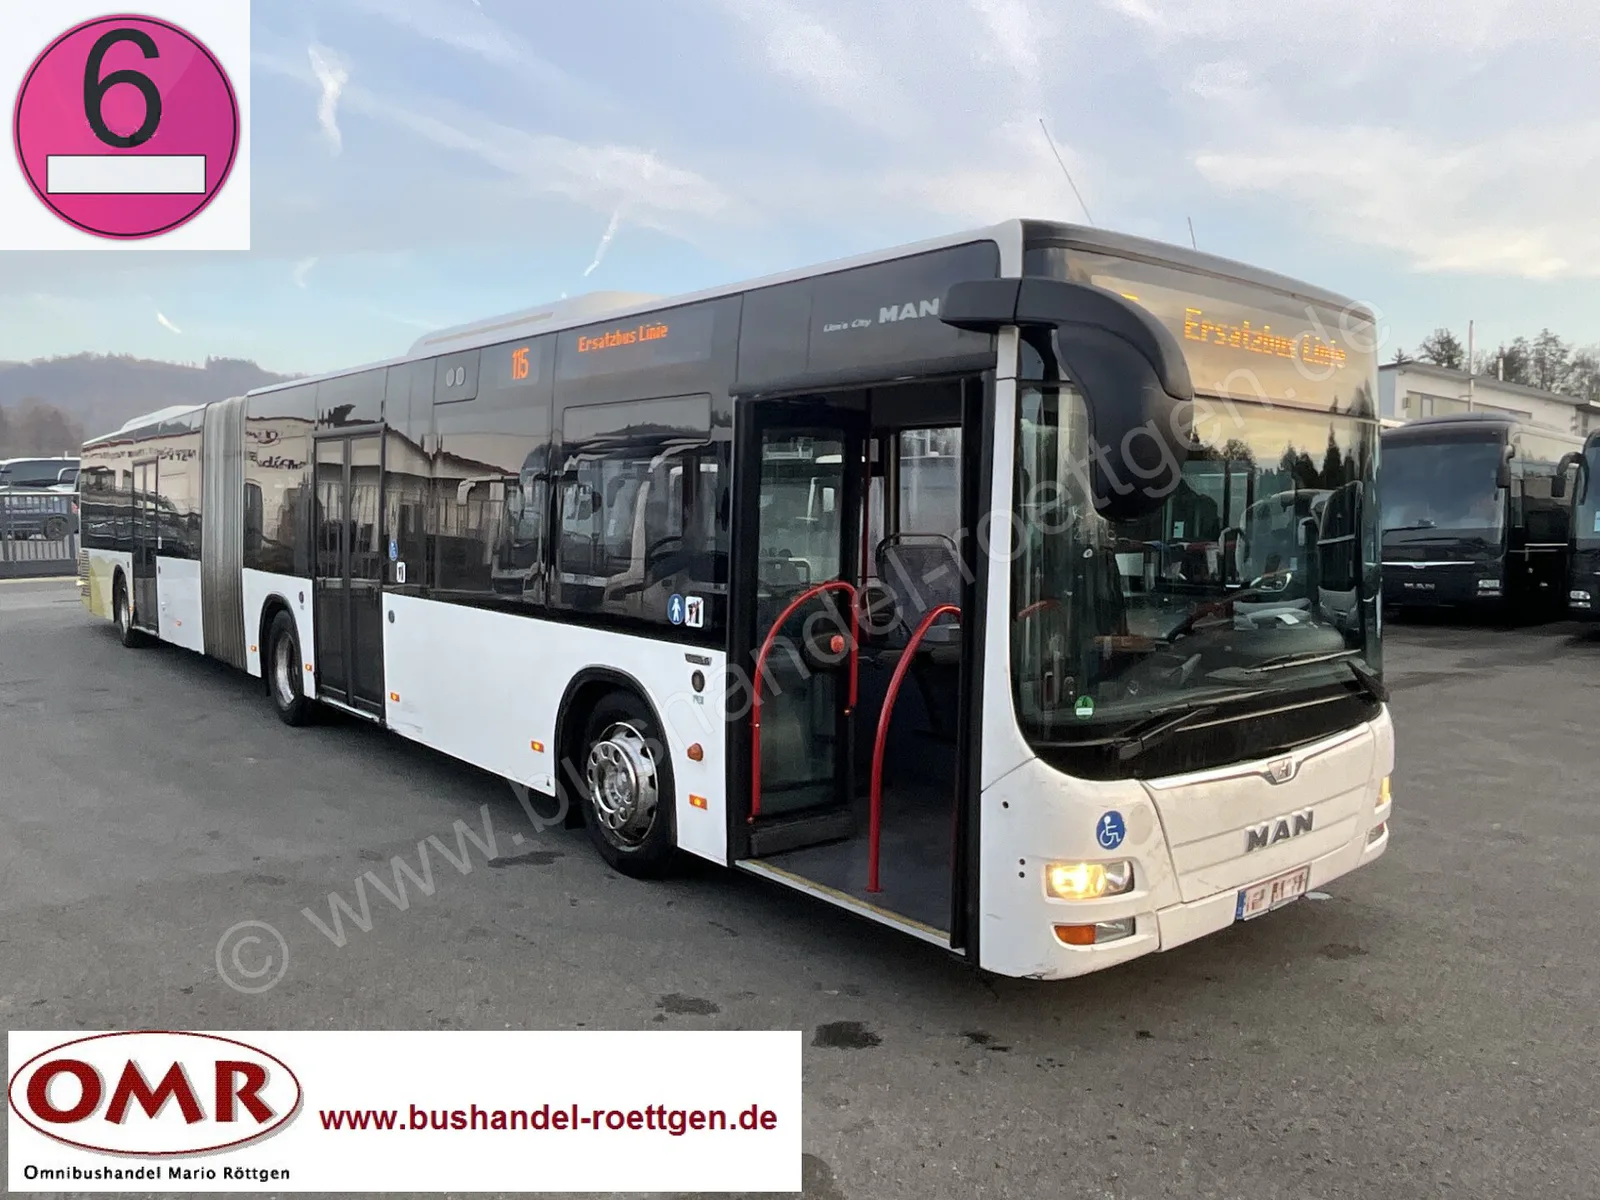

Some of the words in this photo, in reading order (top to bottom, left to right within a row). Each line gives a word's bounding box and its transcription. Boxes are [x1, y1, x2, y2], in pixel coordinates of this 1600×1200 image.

[879, 298, 939, 323] MAN
[578, 330, 635, 352] Ersatzbus
[639, 322, 668, 342] Linie
[1184, 307, 1297, 359] Ersatzbus
[512, 347, 530, 380] 115
[1244, 806, 1314, 854] MAN
